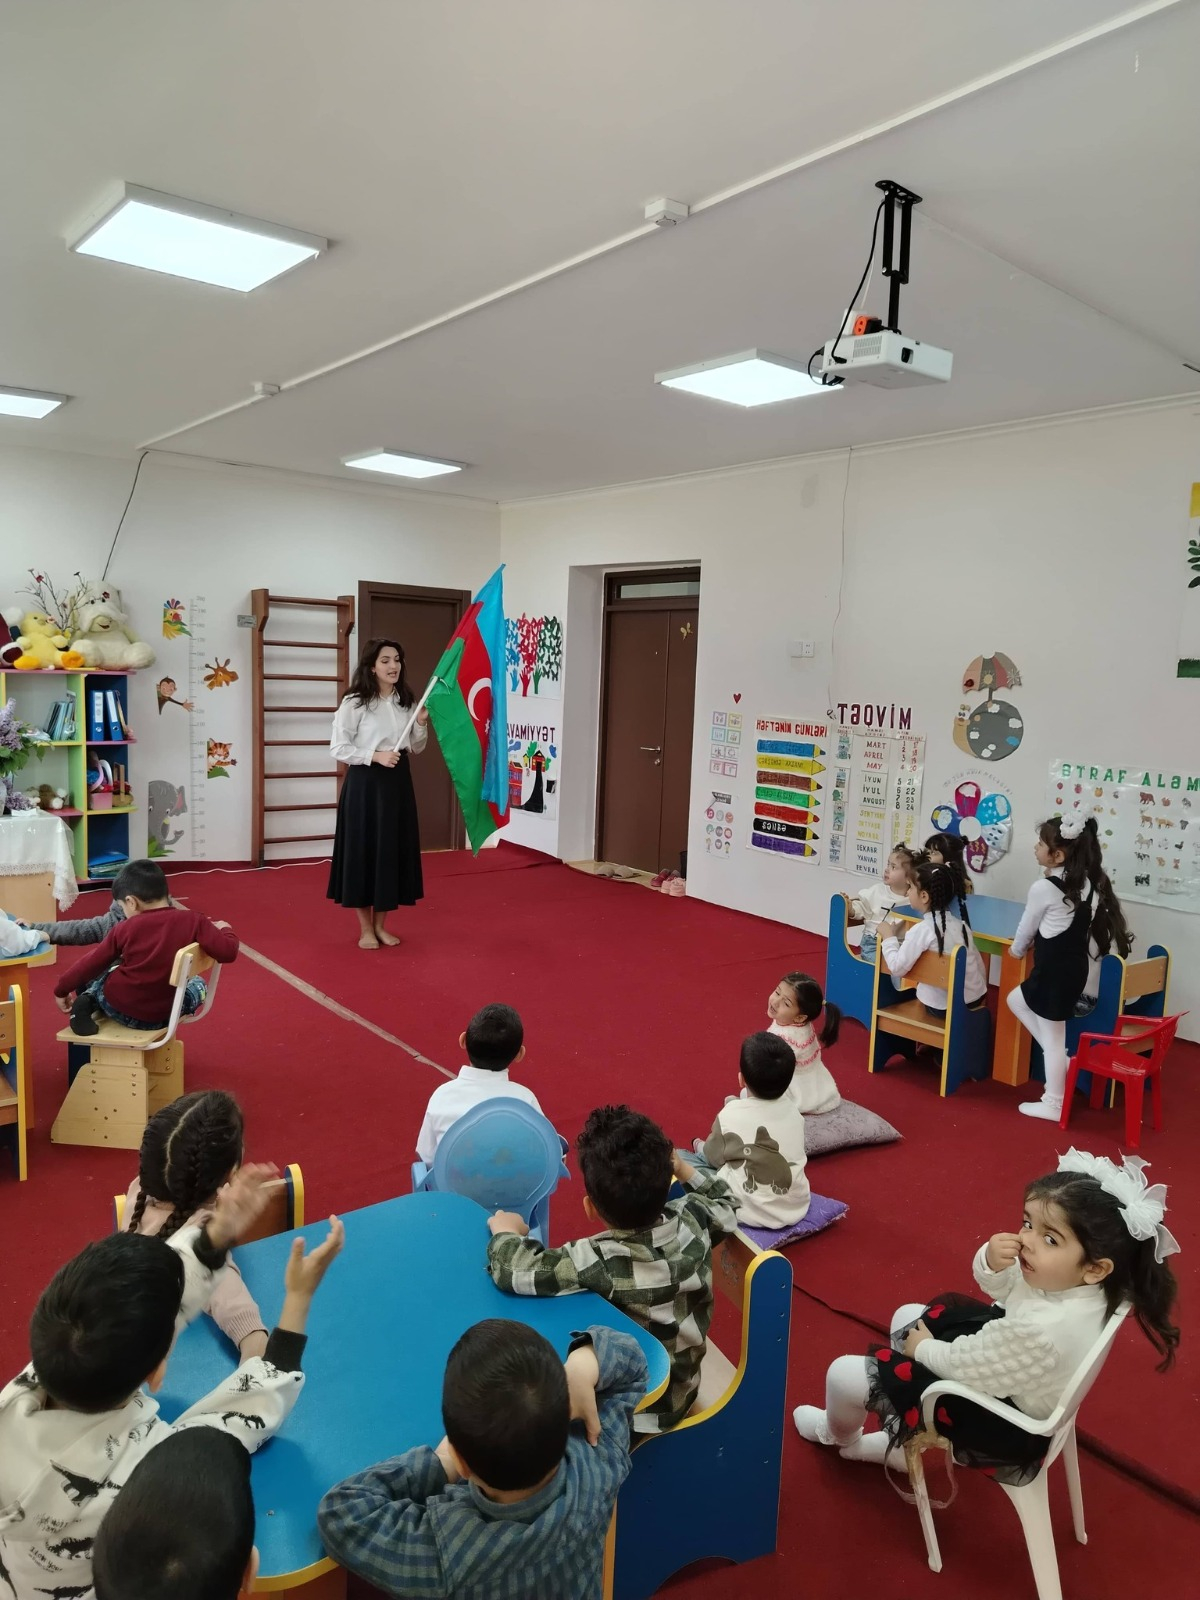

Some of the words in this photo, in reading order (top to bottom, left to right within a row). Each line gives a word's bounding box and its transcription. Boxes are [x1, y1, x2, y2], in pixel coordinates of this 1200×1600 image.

[837, 703, 912, 730] TƏQVİM
[867, 741, 887, 749] MART
[866, 762, 883, 770] MAY
